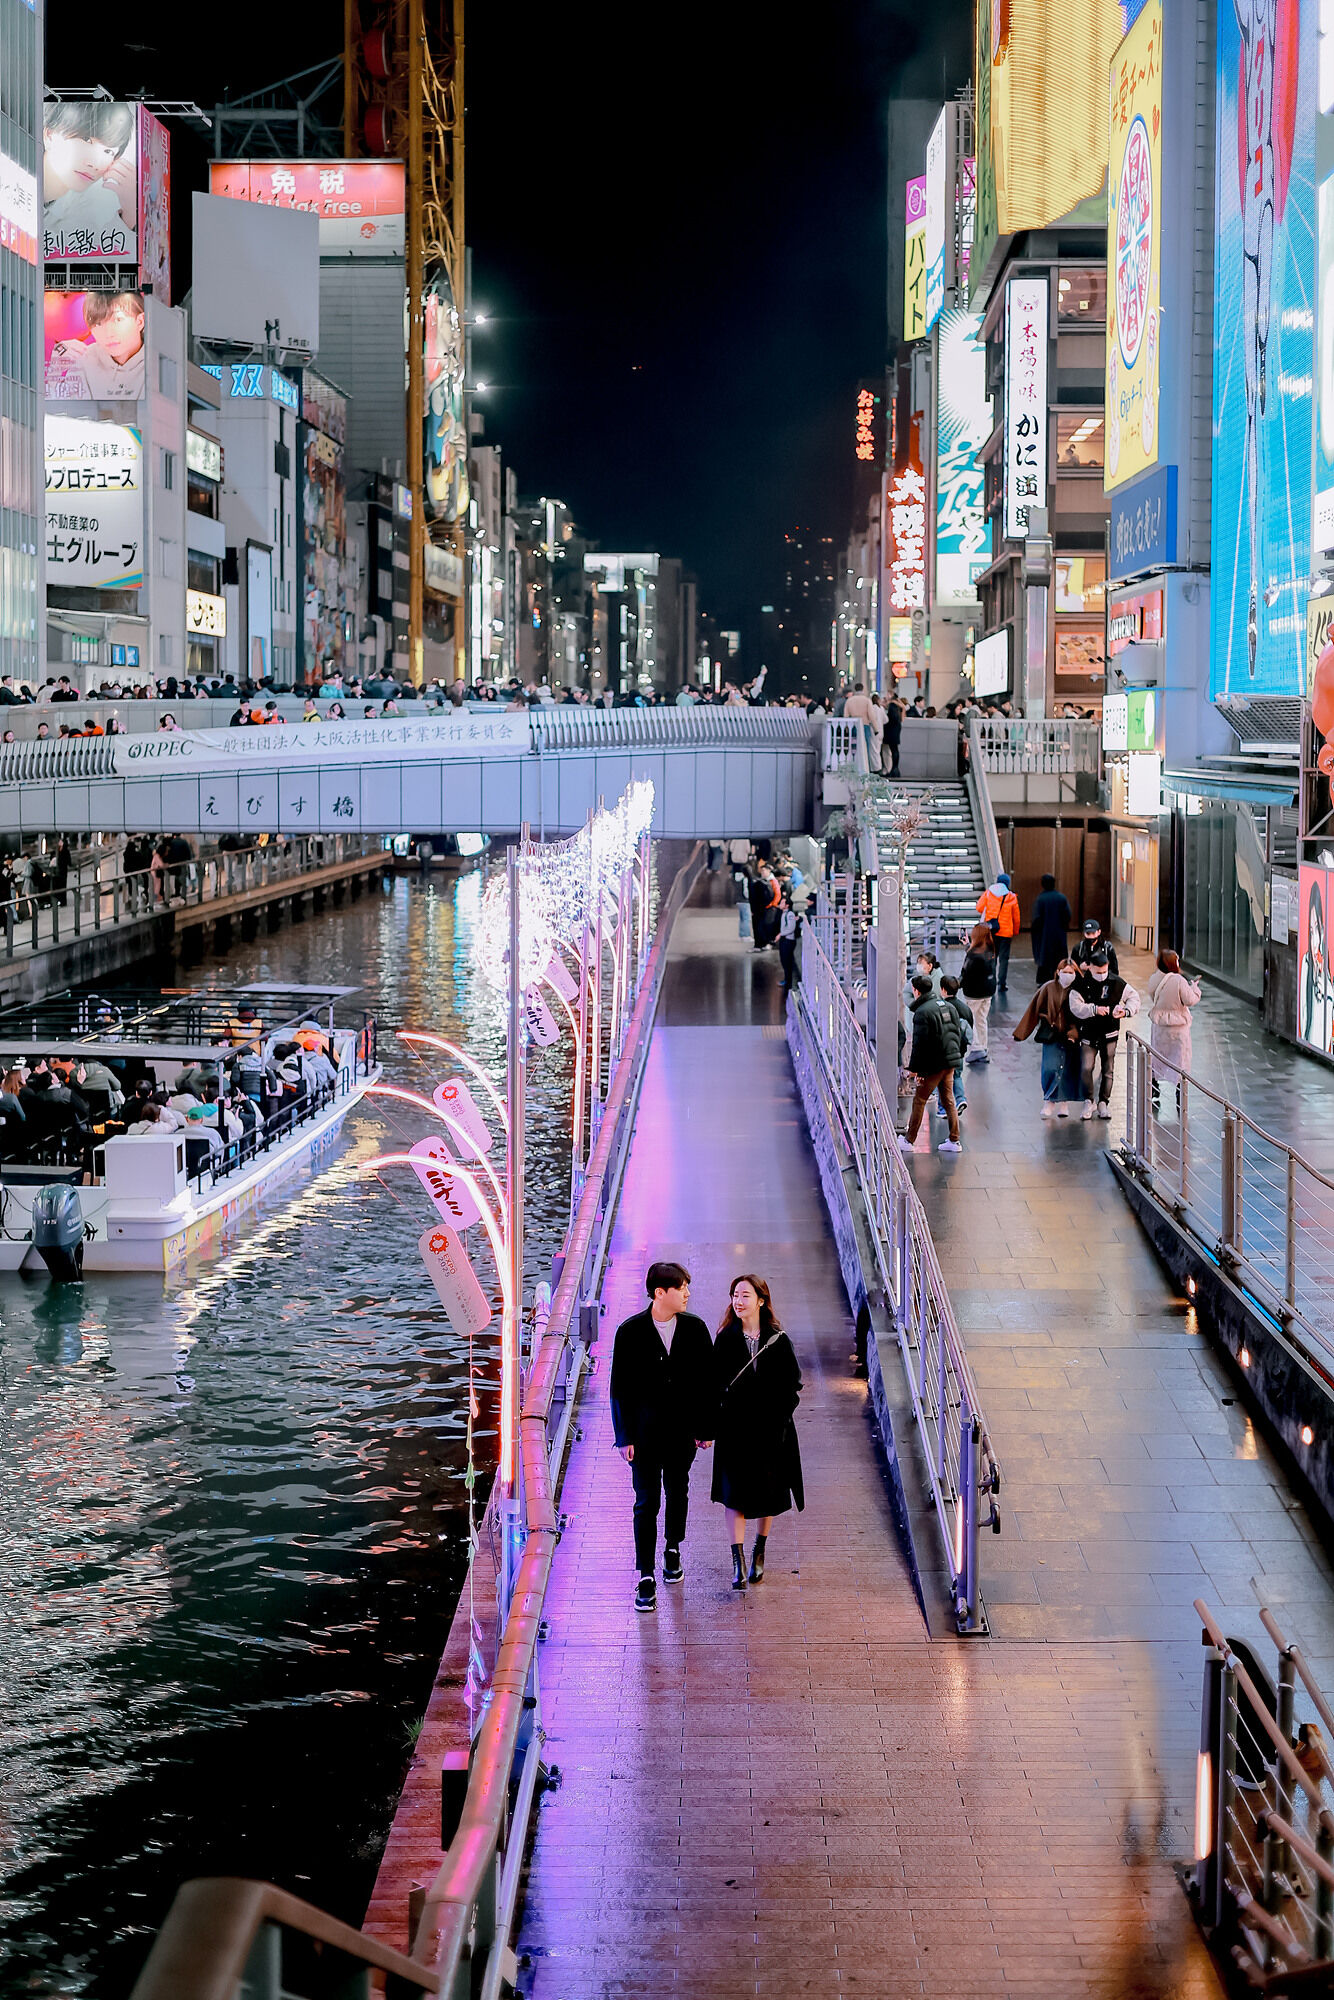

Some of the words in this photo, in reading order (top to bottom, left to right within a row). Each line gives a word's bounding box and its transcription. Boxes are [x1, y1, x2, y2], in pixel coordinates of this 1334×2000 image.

[1255, 23, 1266, 198] グリコ
[271, 169, 345, 195] 免税
[325, 199, 362, 214] Free
[44, 228, 126, 257] 刺激的
[909, 231, 926, 335] バイト
[1018, 320, 1037, 402] 本場の味
[856, 389, 875, 460] お好み焼
[888, 468, 926, 609] 大阪王将
[128, 739, 195, 759] ORPEC
[204, 796, 354, 817] えびす橋
[438, 1257, 450, 1278] 2025
[443, 1253, 456, 1275] EXPO
